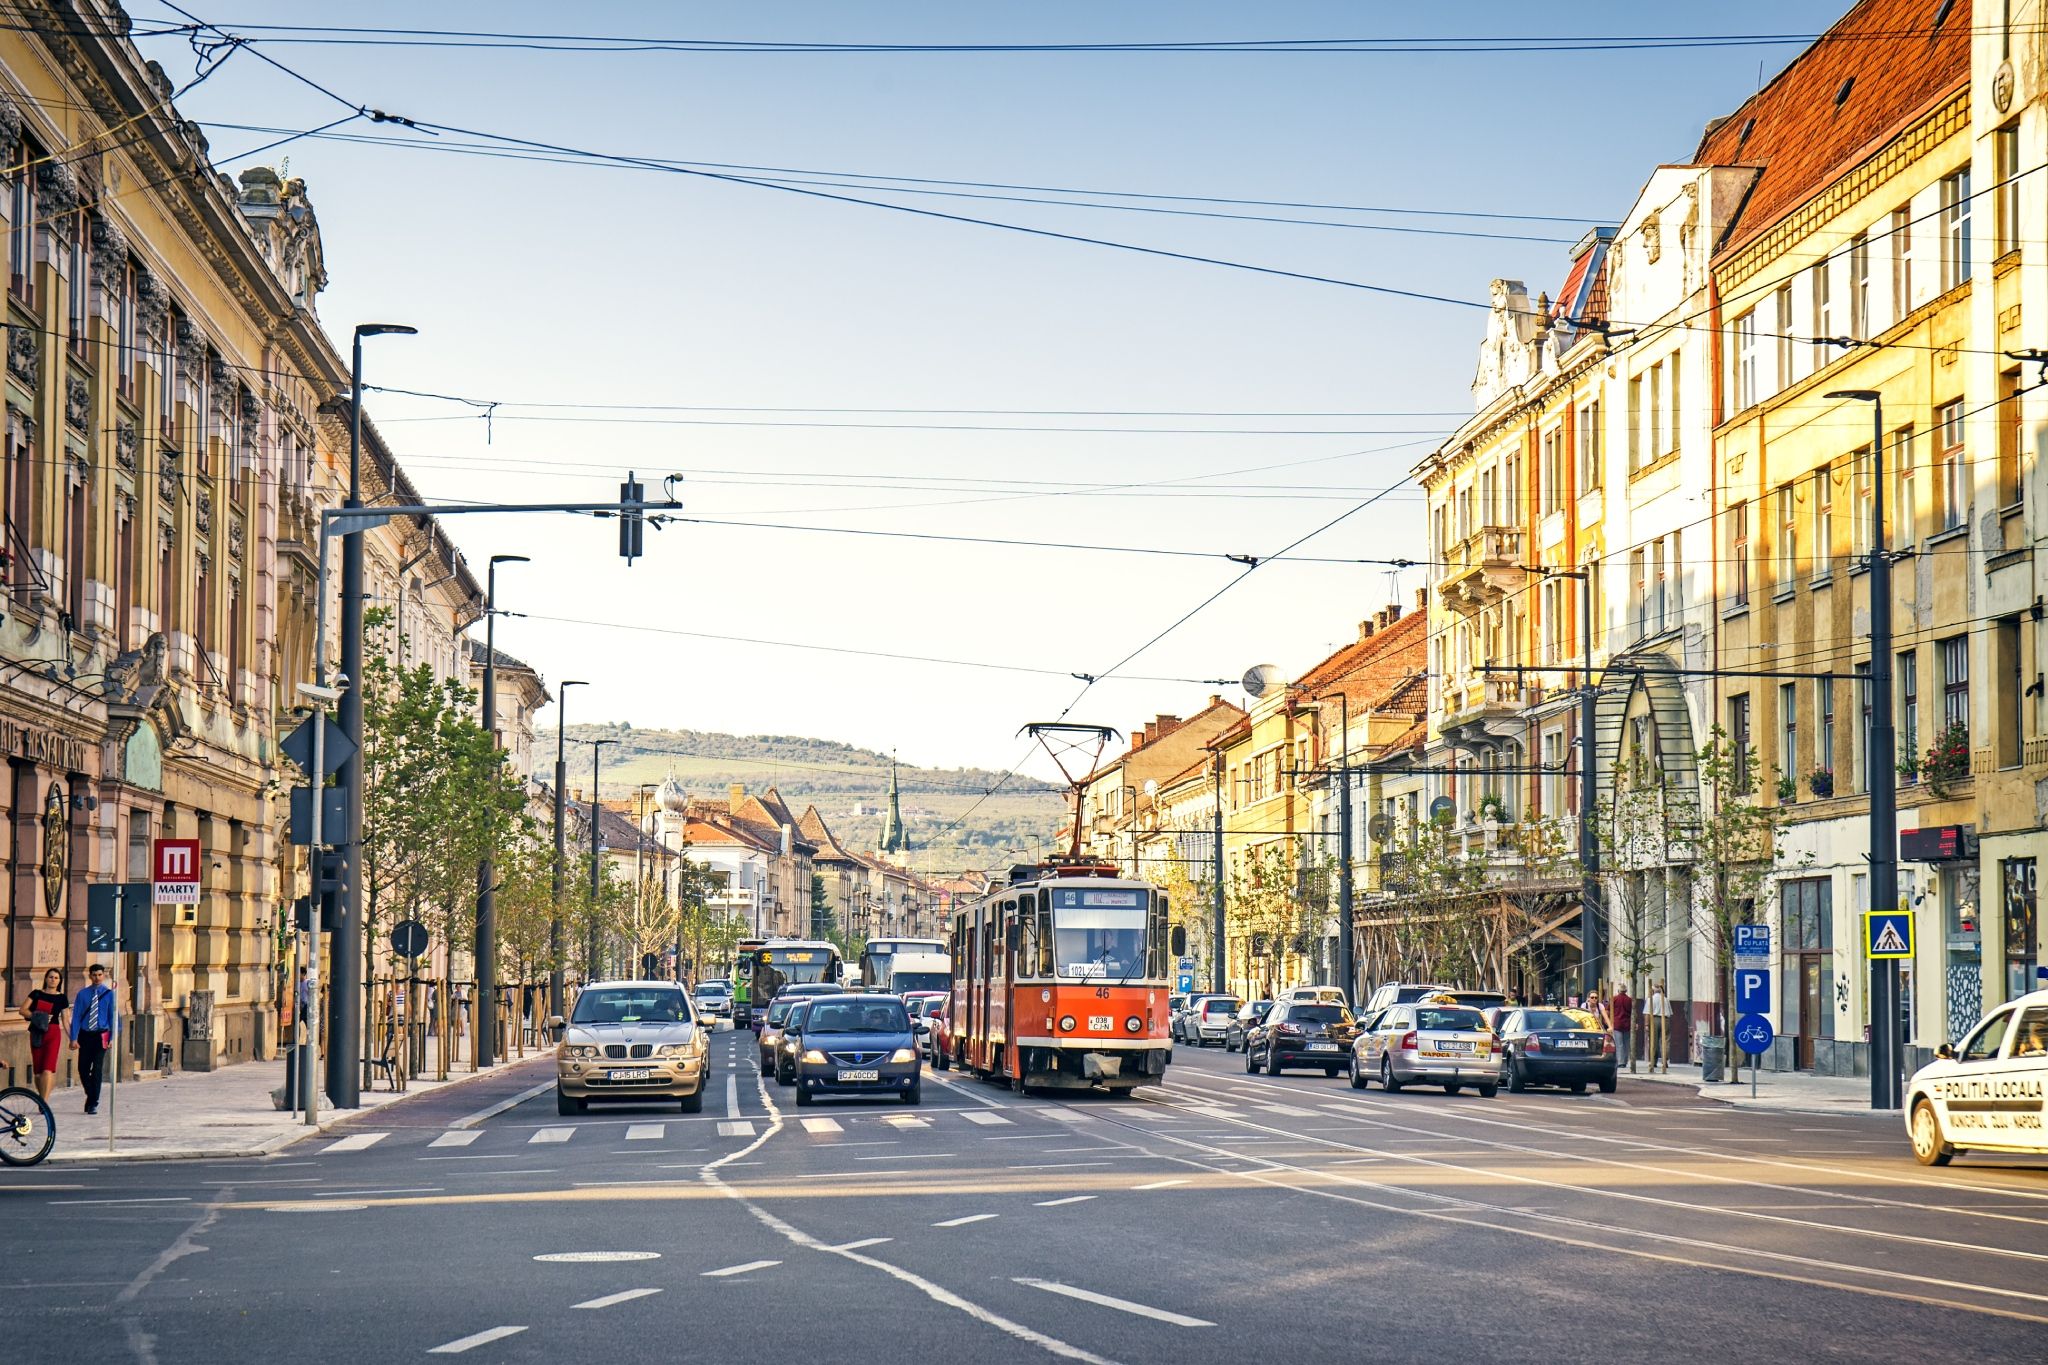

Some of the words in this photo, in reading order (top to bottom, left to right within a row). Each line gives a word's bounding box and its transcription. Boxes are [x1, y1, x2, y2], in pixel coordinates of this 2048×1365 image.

[28, 728, 86, 772] RESTAURANT
[158, 884, 195, 894] MARTY
[1738, 927, 1751, 946] P
[762, 952, 773, 963] 35
[1182, 977, 1190, 987] P
[1744, 974, 1762, 999] P
[1096, 988, 1109, 999] 46
[1946, 1082, 1990, 1098] POLITIA
[1994, 1081, 2043, 1098] LOCALA
